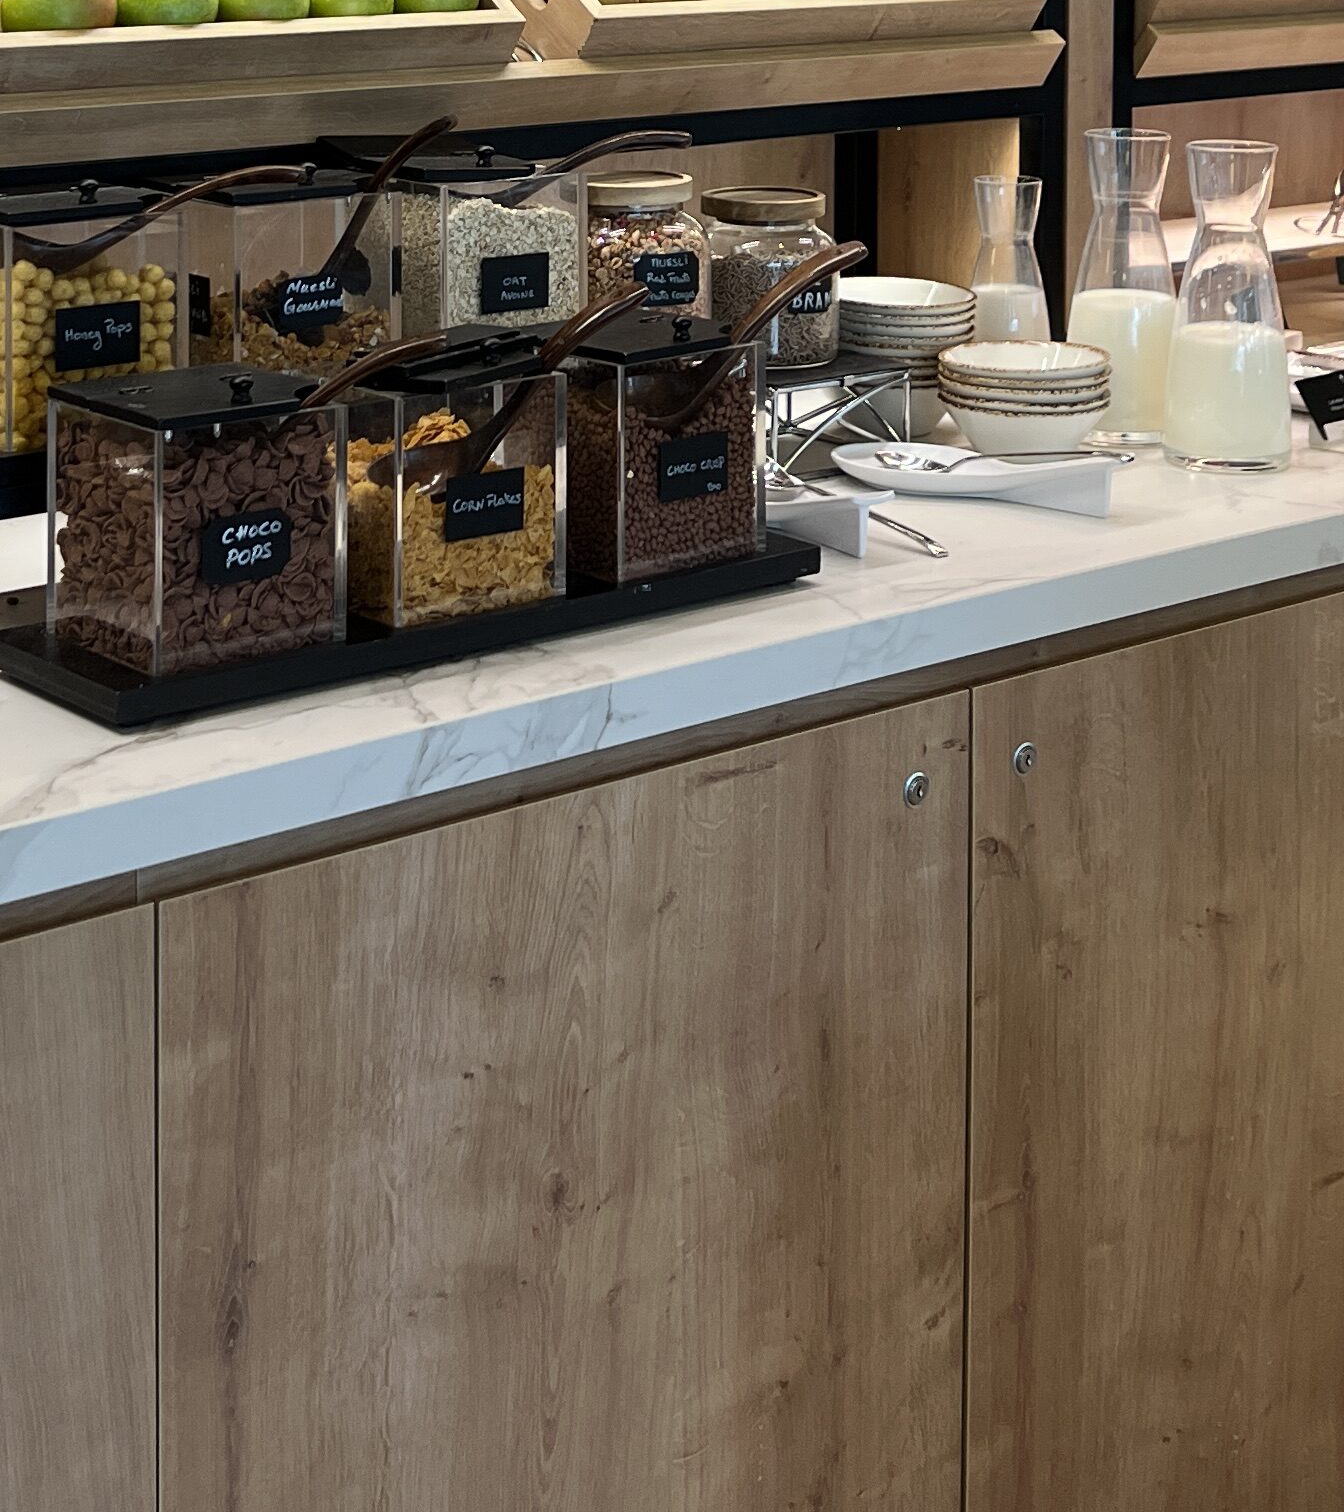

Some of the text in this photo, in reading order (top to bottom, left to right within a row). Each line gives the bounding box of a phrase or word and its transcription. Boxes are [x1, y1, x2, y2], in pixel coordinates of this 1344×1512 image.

[286, 276, 338, 295] Muesli
[502, 276, 528, 287] OAT
[64, 318, 133, 351] Honey Pops
[666, 462, 697, 477] CHOCO
[452, 498, 485, 514] CORN
[221, 520, 282, 545] CHOCO
[226, 541, 273, 569] POPS
